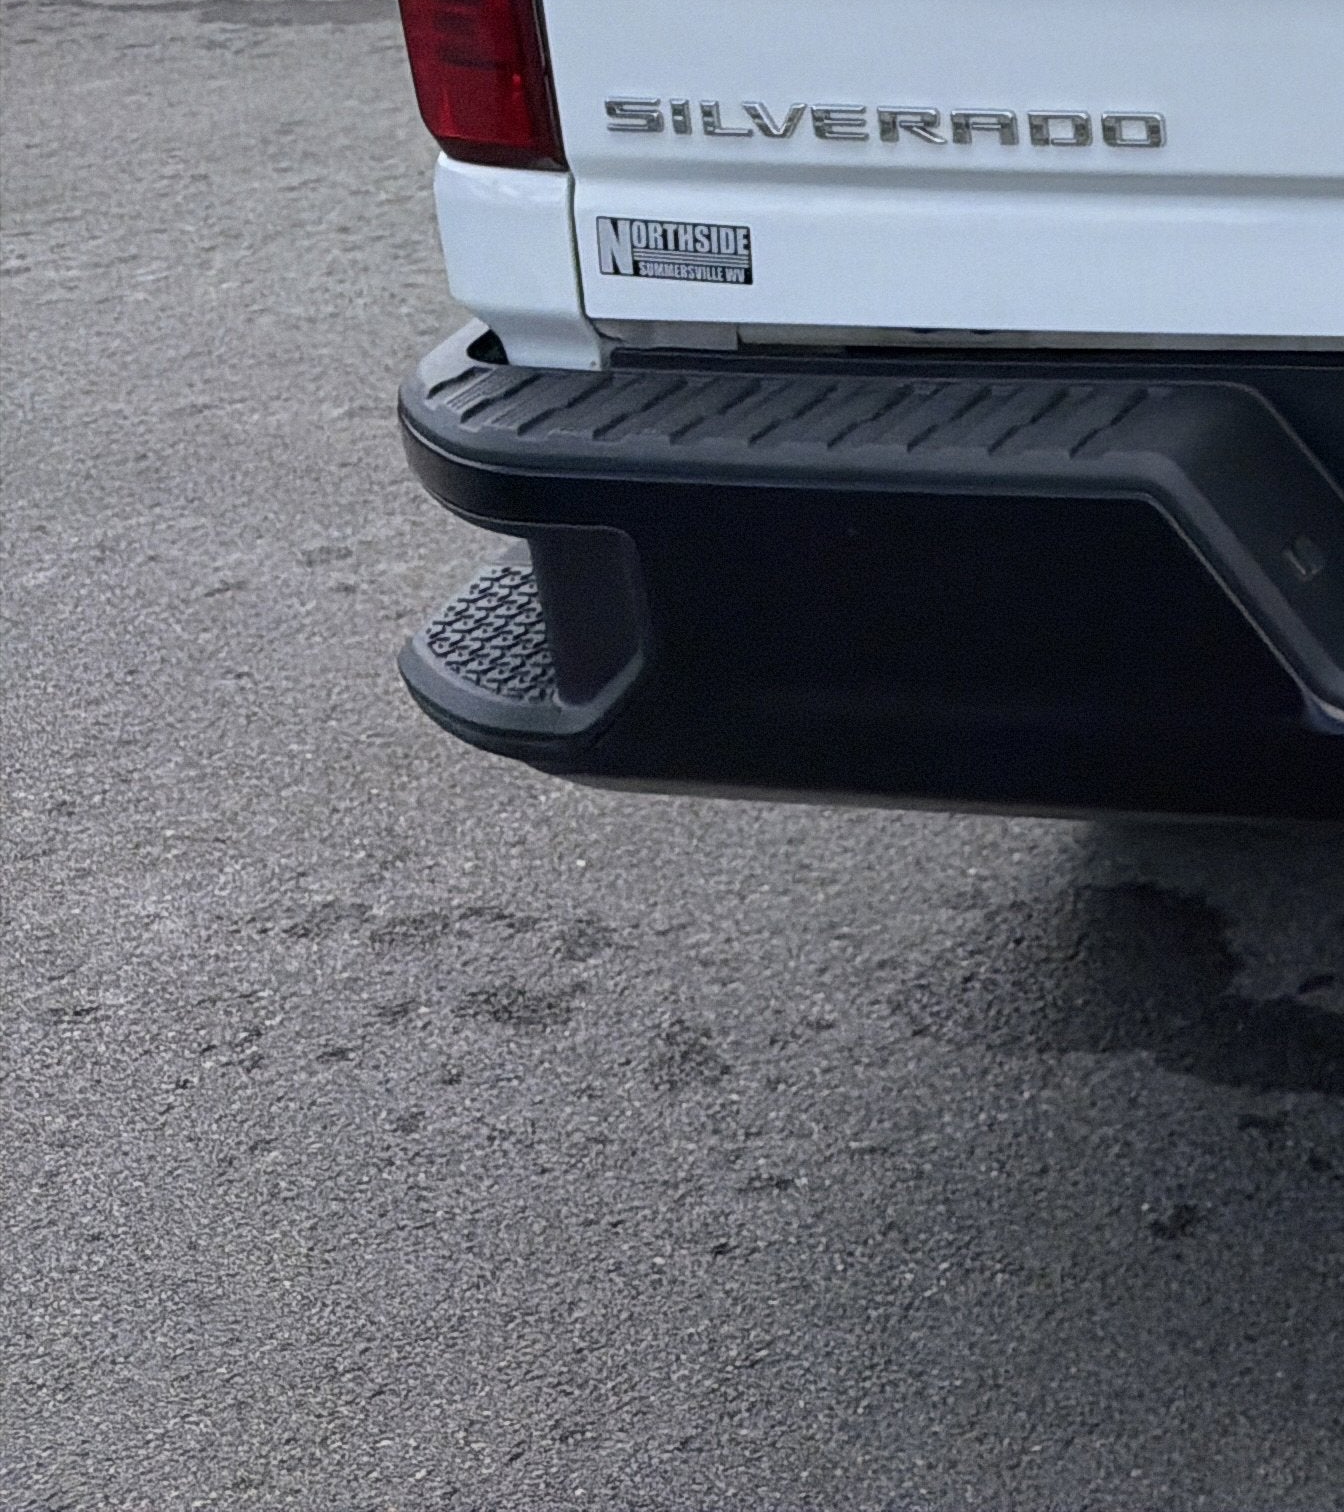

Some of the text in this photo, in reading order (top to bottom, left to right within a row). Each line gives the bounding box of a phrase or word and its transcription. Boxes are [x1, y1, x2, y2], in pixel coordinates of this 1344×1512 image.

[603, 98, 1167, 148] SILVERADO
[598, 218, 749, 274] NORTHSIDE
[638, 261, 745, 283] SUMMERSVILLE WV
